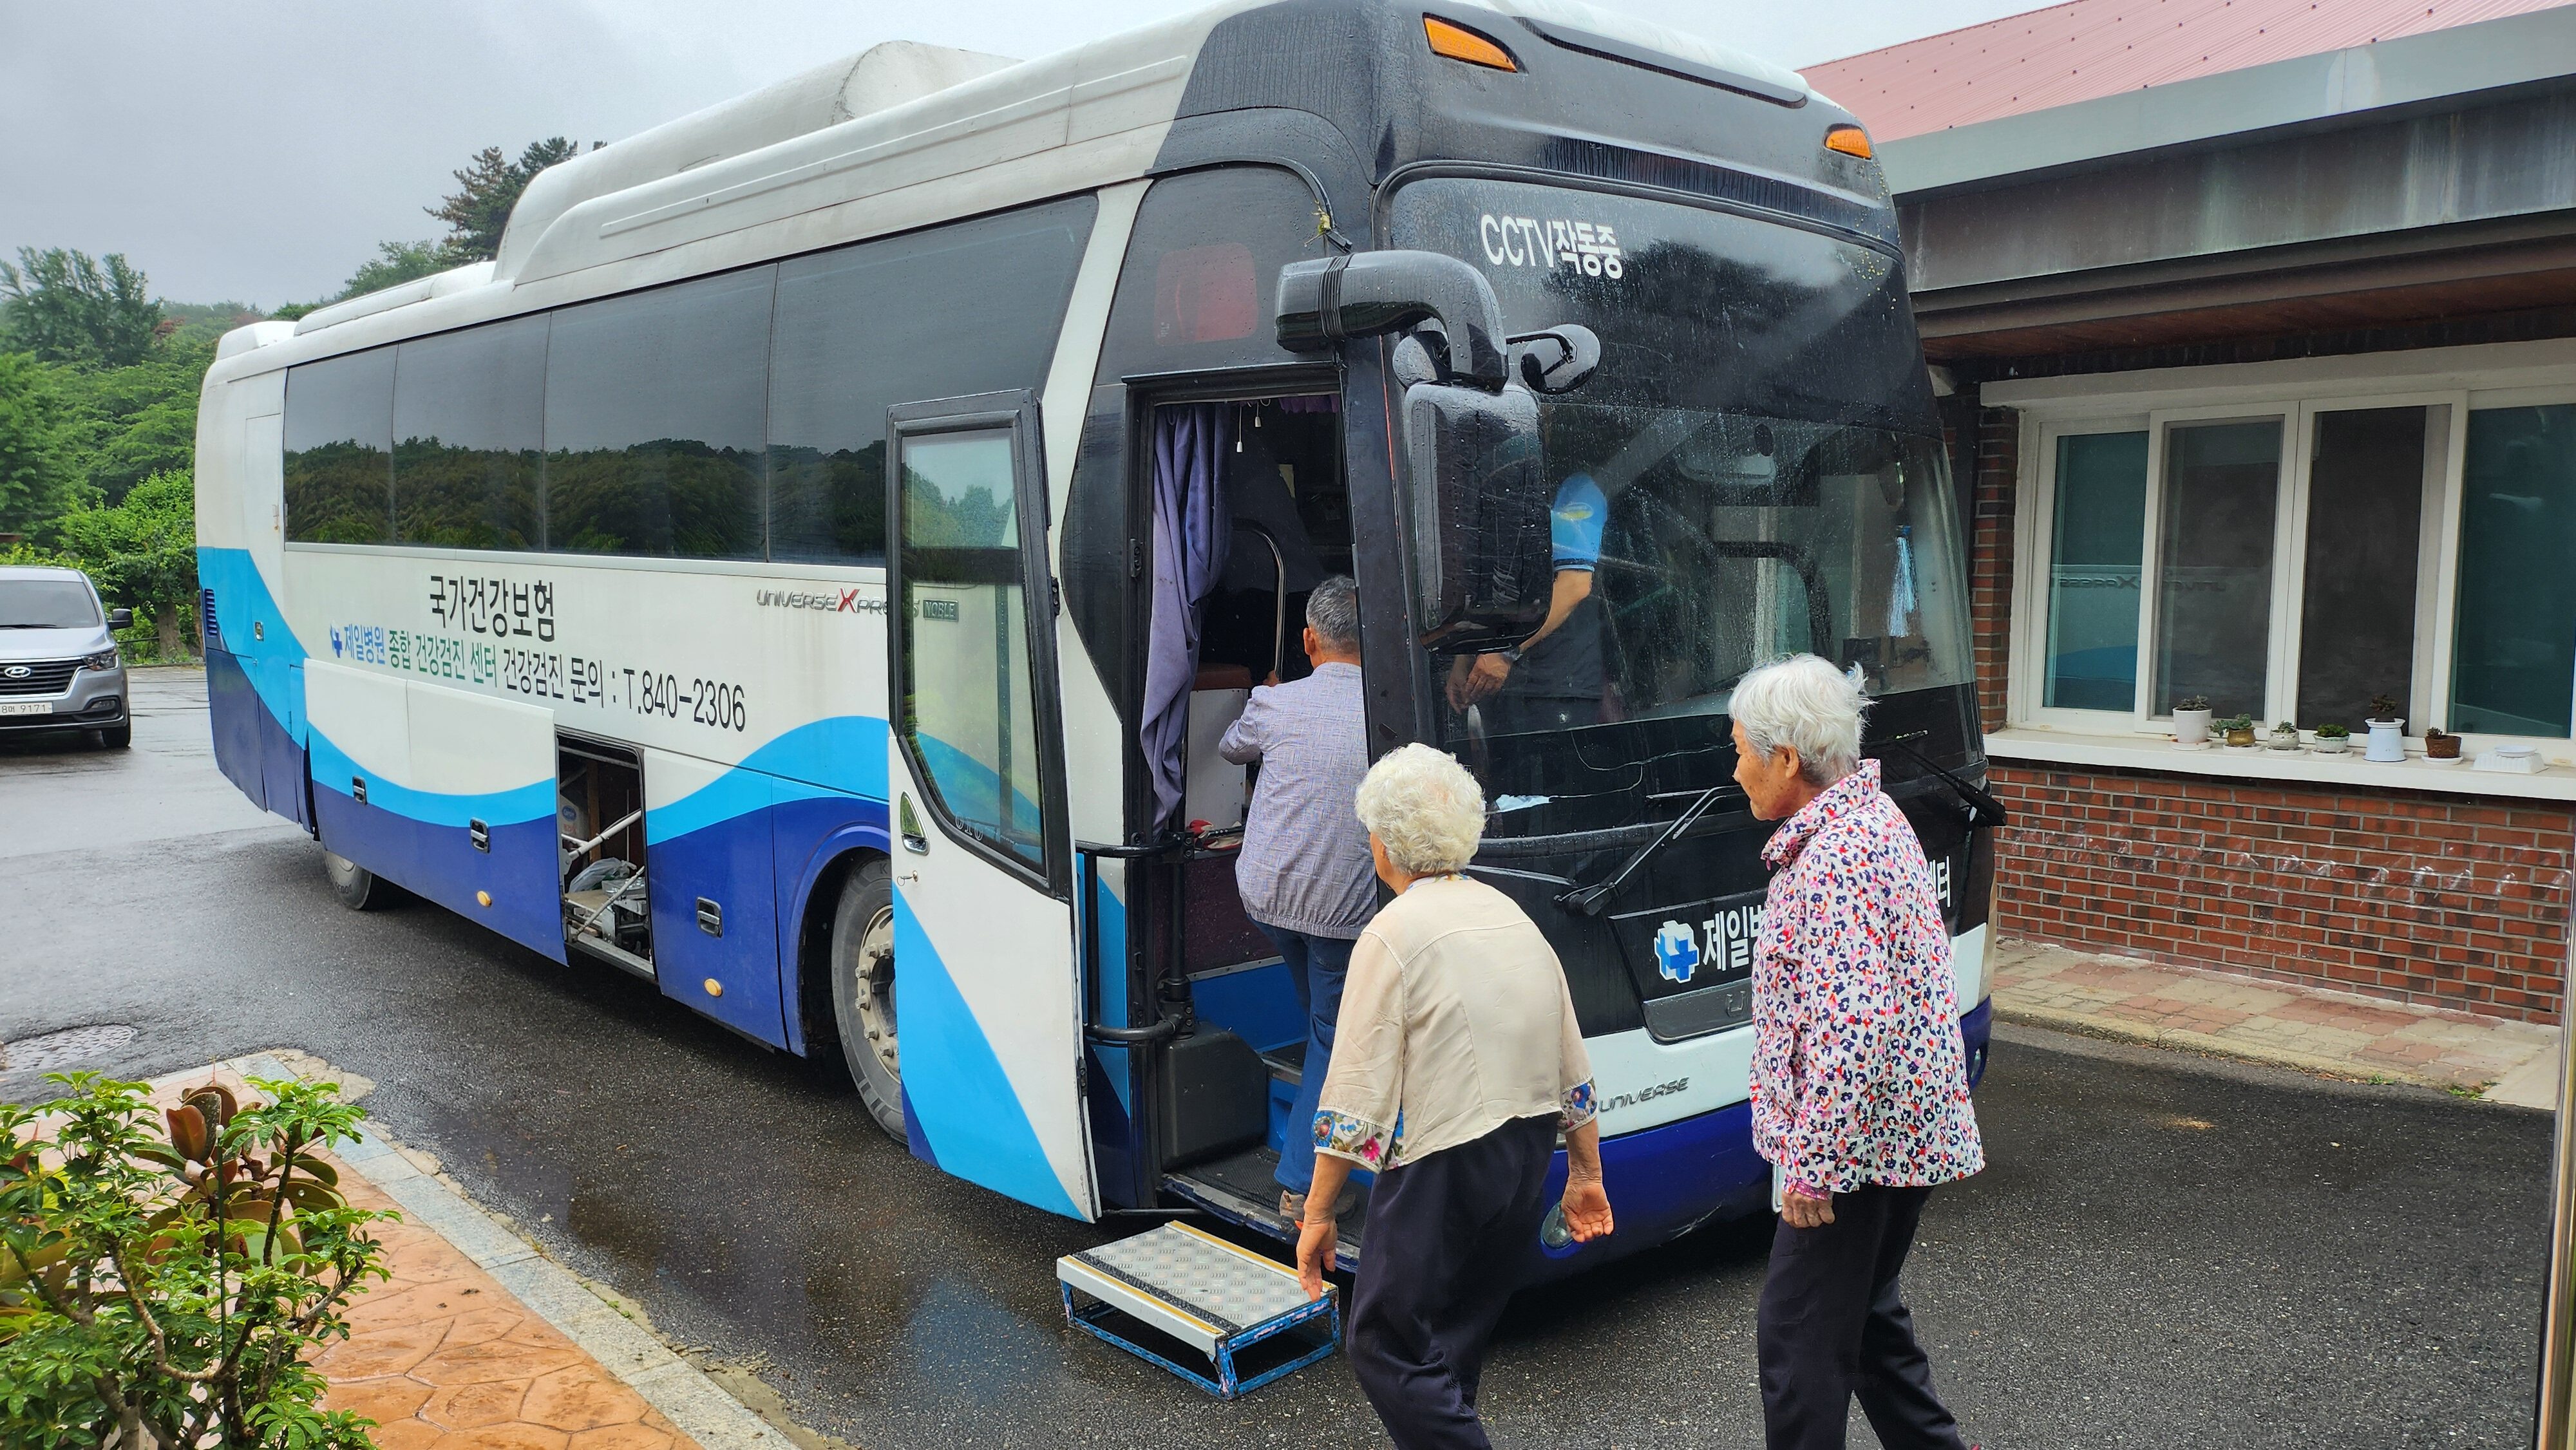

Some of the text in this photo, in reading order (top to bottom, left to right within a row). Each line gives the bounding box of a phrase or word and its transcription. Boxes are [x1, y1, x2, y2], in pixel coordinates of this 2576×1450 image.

[1481, 214, 1623, 279] CCTV작동중
[430, 575, 555, 643] 국가건강보험
[925, 601, 955, 618] NOBLE
[344, 623, 385, 665] 제일병원
[389, 630, 411, 670] 종합
[415, 634, 466, 680] 건강검진
[471, 642, 497, 688] 센터
[503, 647, 564, 700] 건강검진
[571, 657, 604, 709] 문의
[623, 668, 746, 732] T.840-2306
[21, 704, 46, 713] 9171
[1598, 1076, 1690, 1113] UNIVERSE
